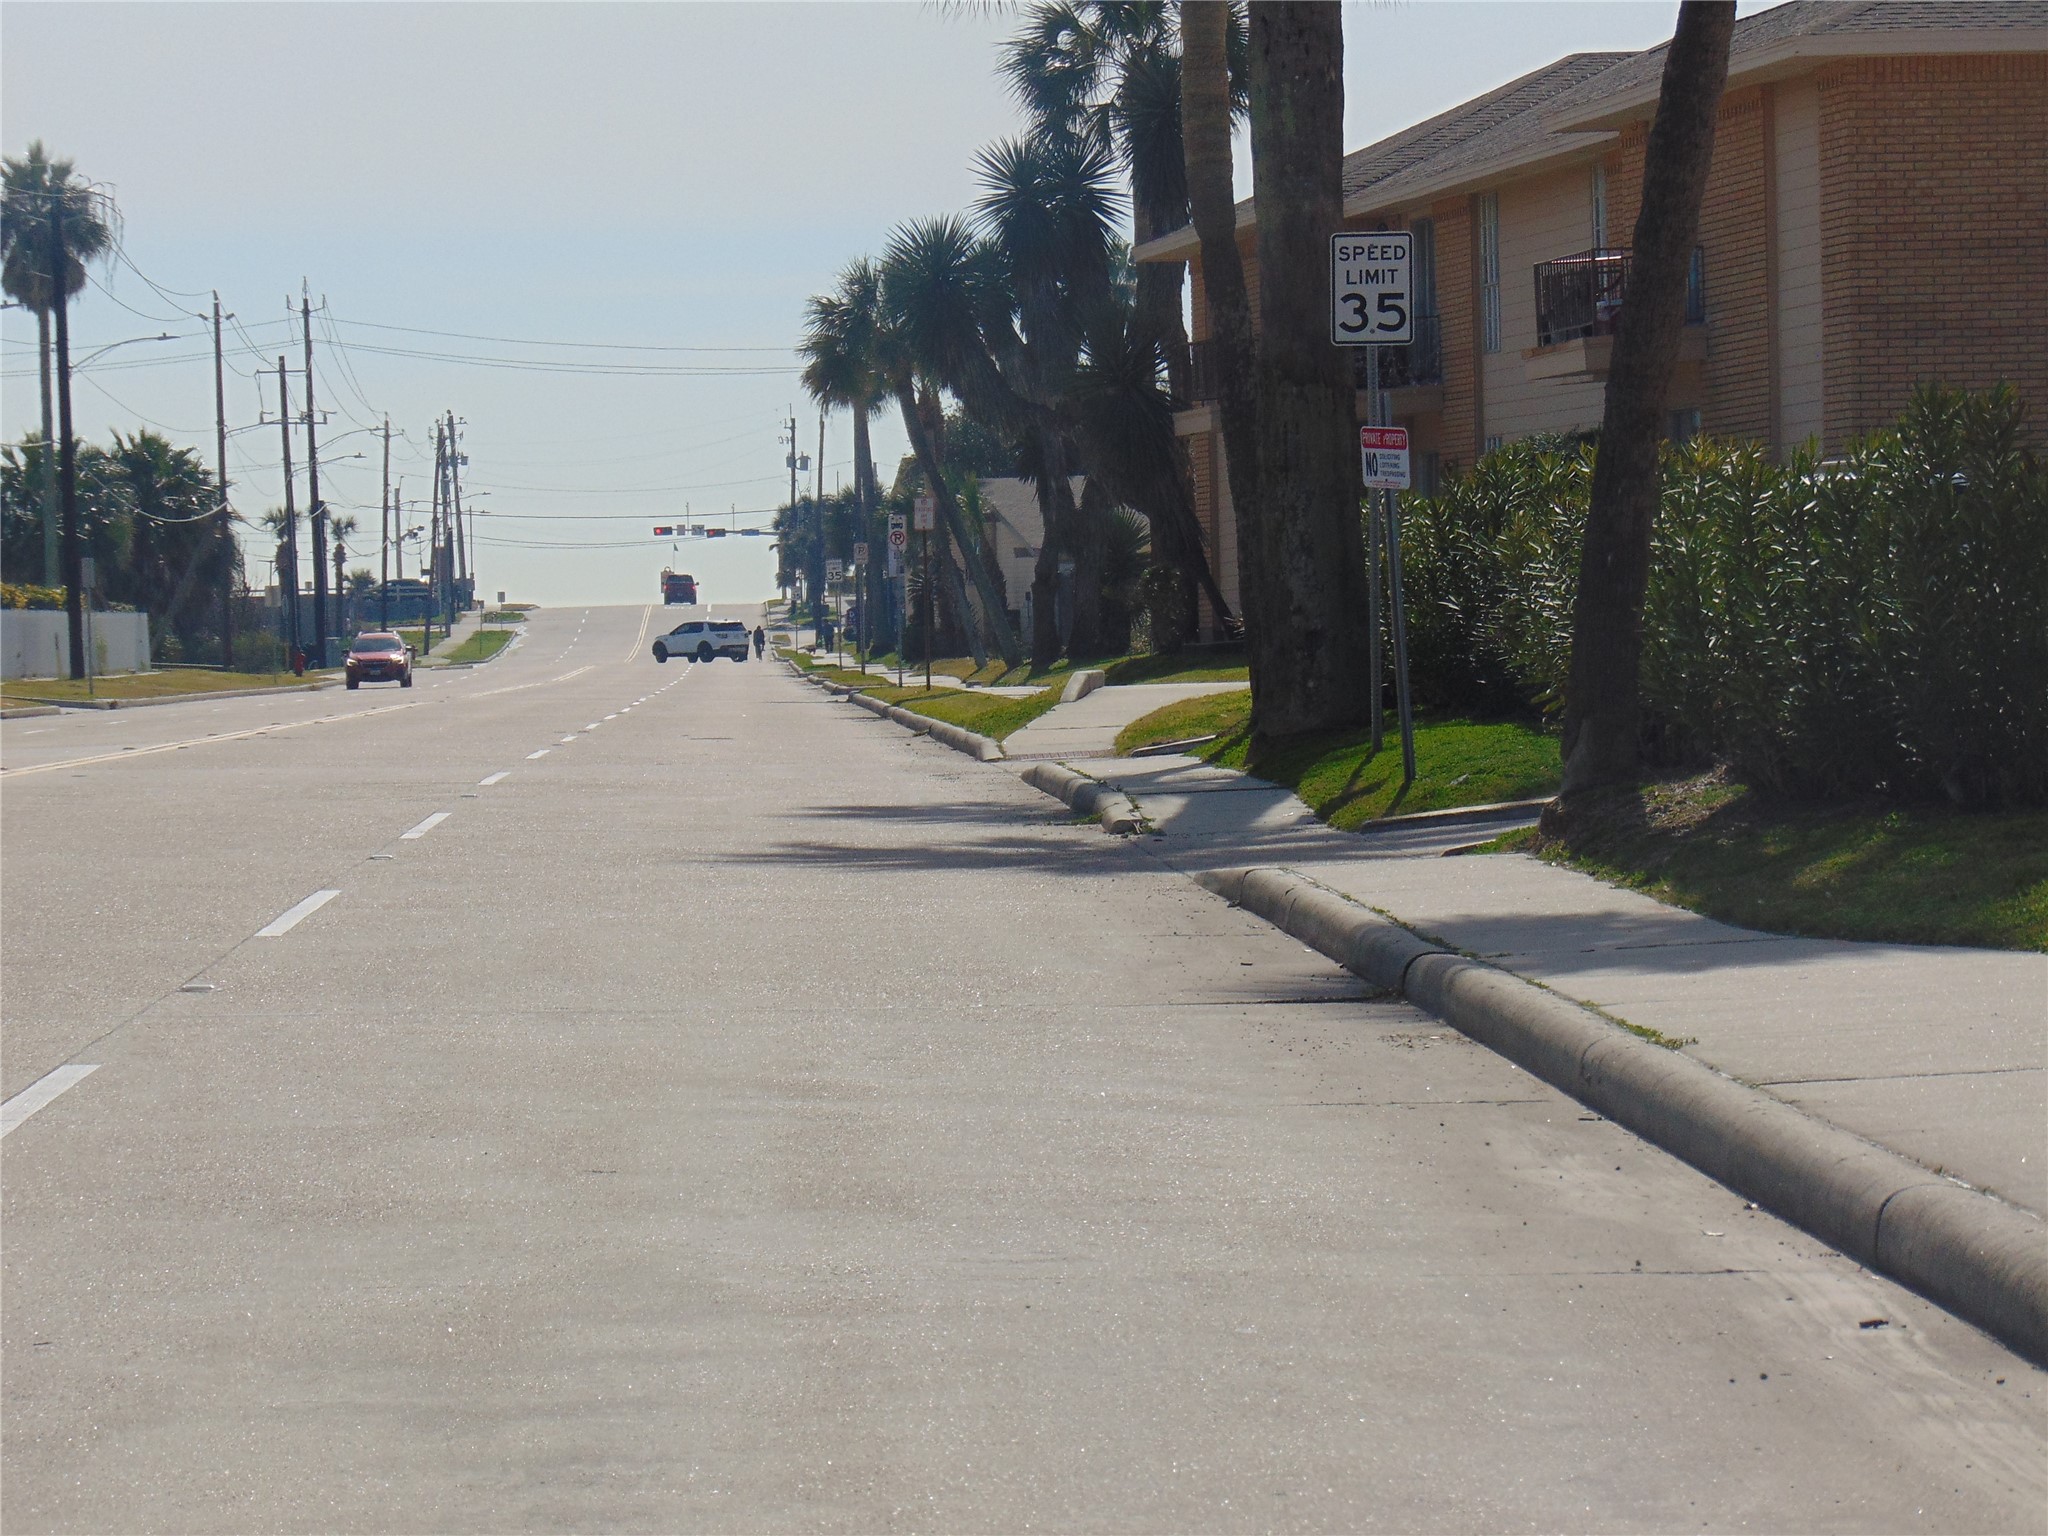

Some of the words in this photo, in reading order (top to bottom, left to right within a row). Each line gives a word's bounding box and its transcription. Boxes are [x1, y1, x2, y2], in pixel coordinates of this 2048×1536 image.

[1338, 245, 1406, 262] SPEED
[1346, 269, 1398, 285] LIMIT
[1339, 292, 1407, 333] 35
[1362, 432, 1381, 445] PRIVATE
[1383, 433, 1406, 446] PROPERTY
[1365, 452, 1378, 477] NO
[827, 571, 842, 580] 35
